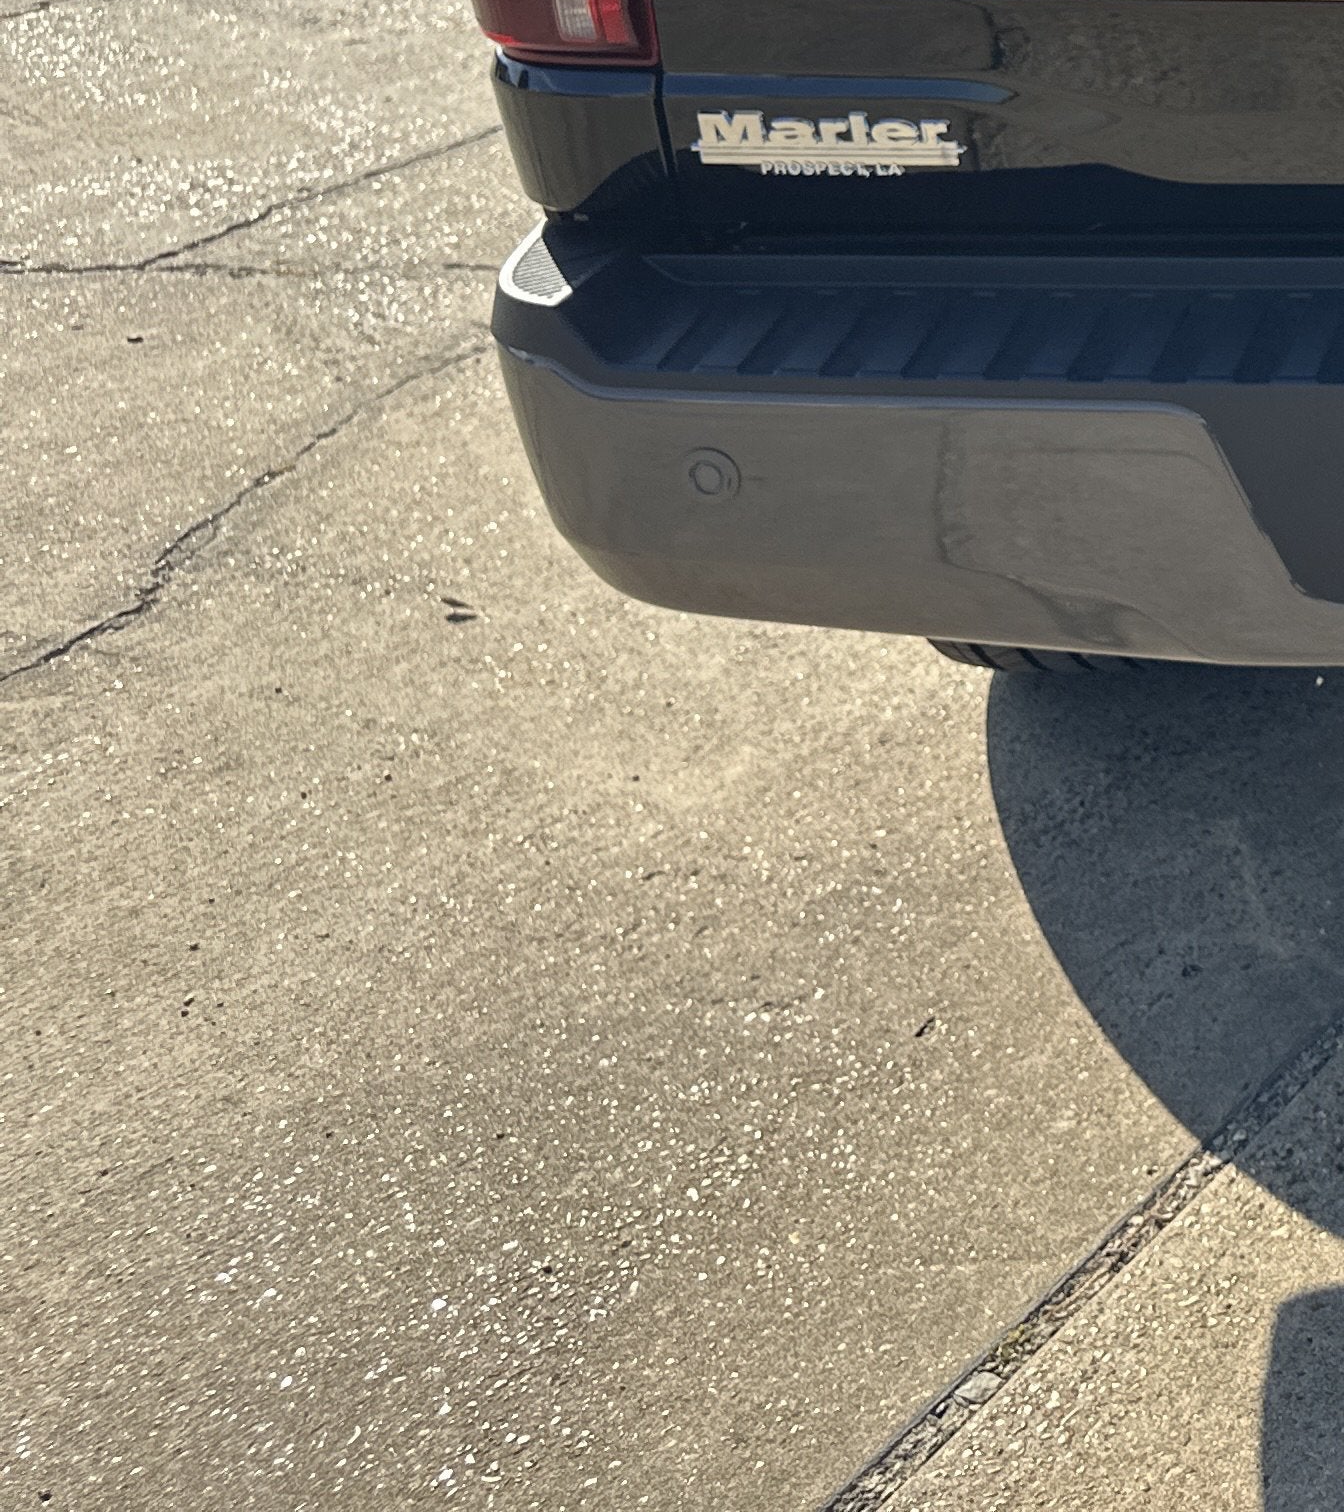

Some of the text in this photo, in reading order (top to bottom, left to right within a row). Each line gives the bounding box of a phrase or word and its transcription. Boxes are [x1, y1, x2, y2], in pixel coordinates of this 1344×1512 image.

[697, 110, 950, 145] Marler
[760, 161, 903, 178] PROSPECT, LA
